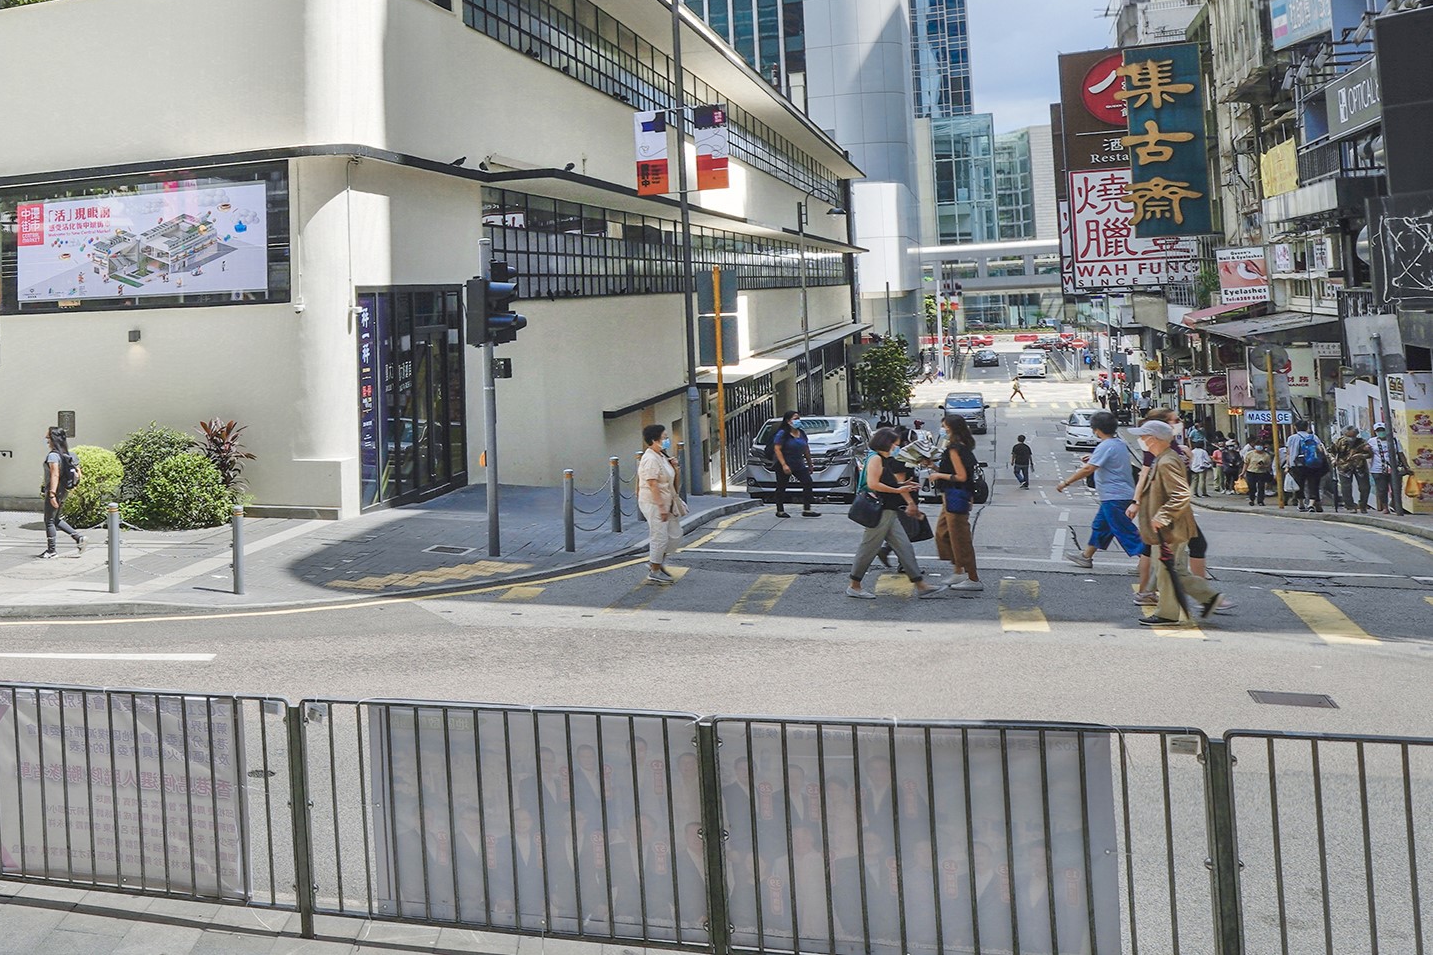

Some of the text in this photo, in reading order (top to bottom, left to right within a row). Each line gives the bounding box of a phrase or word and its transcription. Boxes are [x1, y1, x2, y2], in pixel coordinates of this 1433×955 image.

[1348, 77, 1376, 115] OPTICAL
[1090, 153, 1129, 164] Resta
[1077, 263, 1128, 277] WAH
[1078, 278, 1139, 287] SINCE
[1224, 288, 1267, 296] Eyelashes
[1248, 413, 1289, 422] MASSGE
